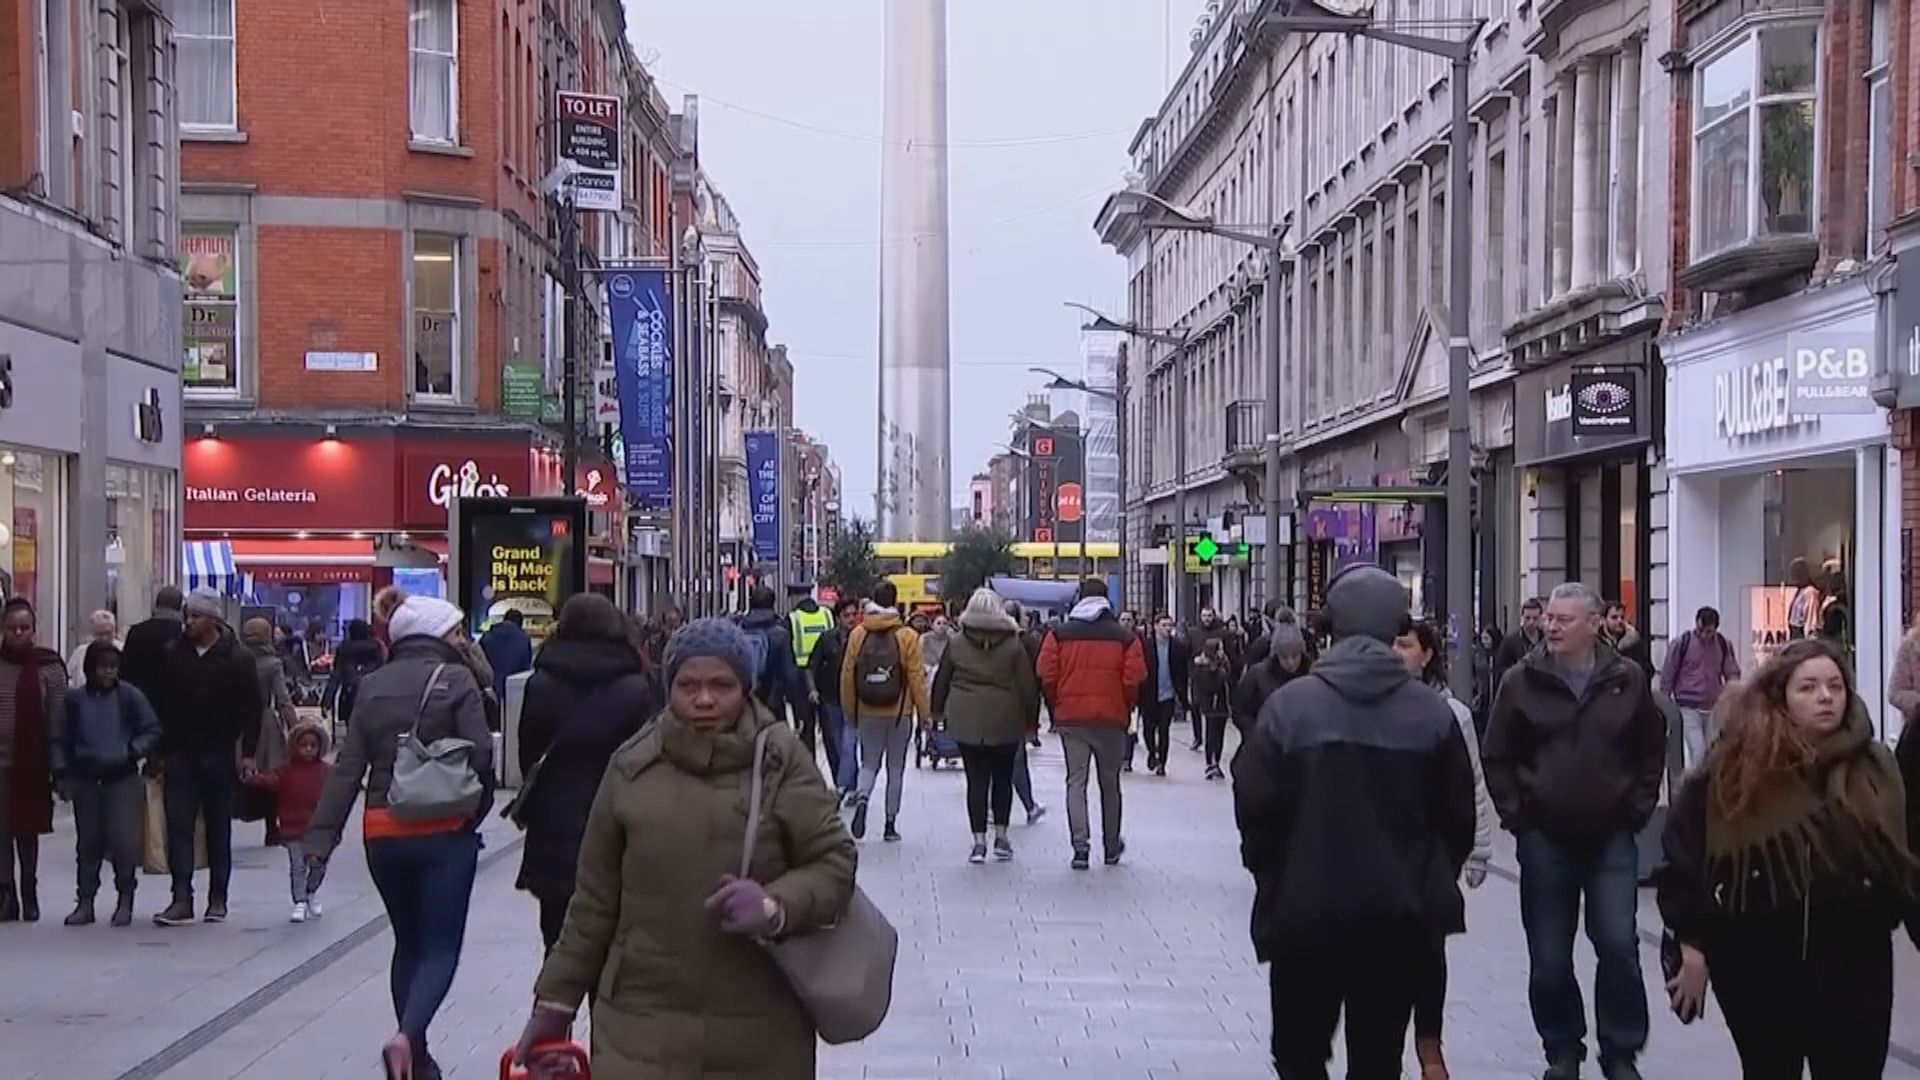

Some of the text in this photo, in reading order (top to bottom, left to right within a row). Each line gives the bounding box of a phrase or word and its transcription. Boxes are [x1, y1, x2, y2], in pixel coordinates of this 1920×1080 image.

[565, 98, 613, 117] TO LET
[192, 307, 217, 322] Dr
[422, 316, 439, 331] Dr
[650, 310, 663, 369] COCKLES
[637, 321, 650, 377] SEABASS
[1796, 349, 1868, 380] P&B
[1716, 357, 1818, 437] PULL&BE
[1796, 385, 1868, 399] PULL&BEAR
[763, 460, 775, 470] AT
[758, 470, 775, 480] THE
[186, 486, 317, 502] Italian Gelateria
[761, 494, 775, 503] OF
[759, 504, 775, 514] THE
[754, 514, 775, 523] CITY
[492, 546, 540, 560] Grand
[492, 560, 553, 578] Big Mac
[492, 576, 547, 592] is back
